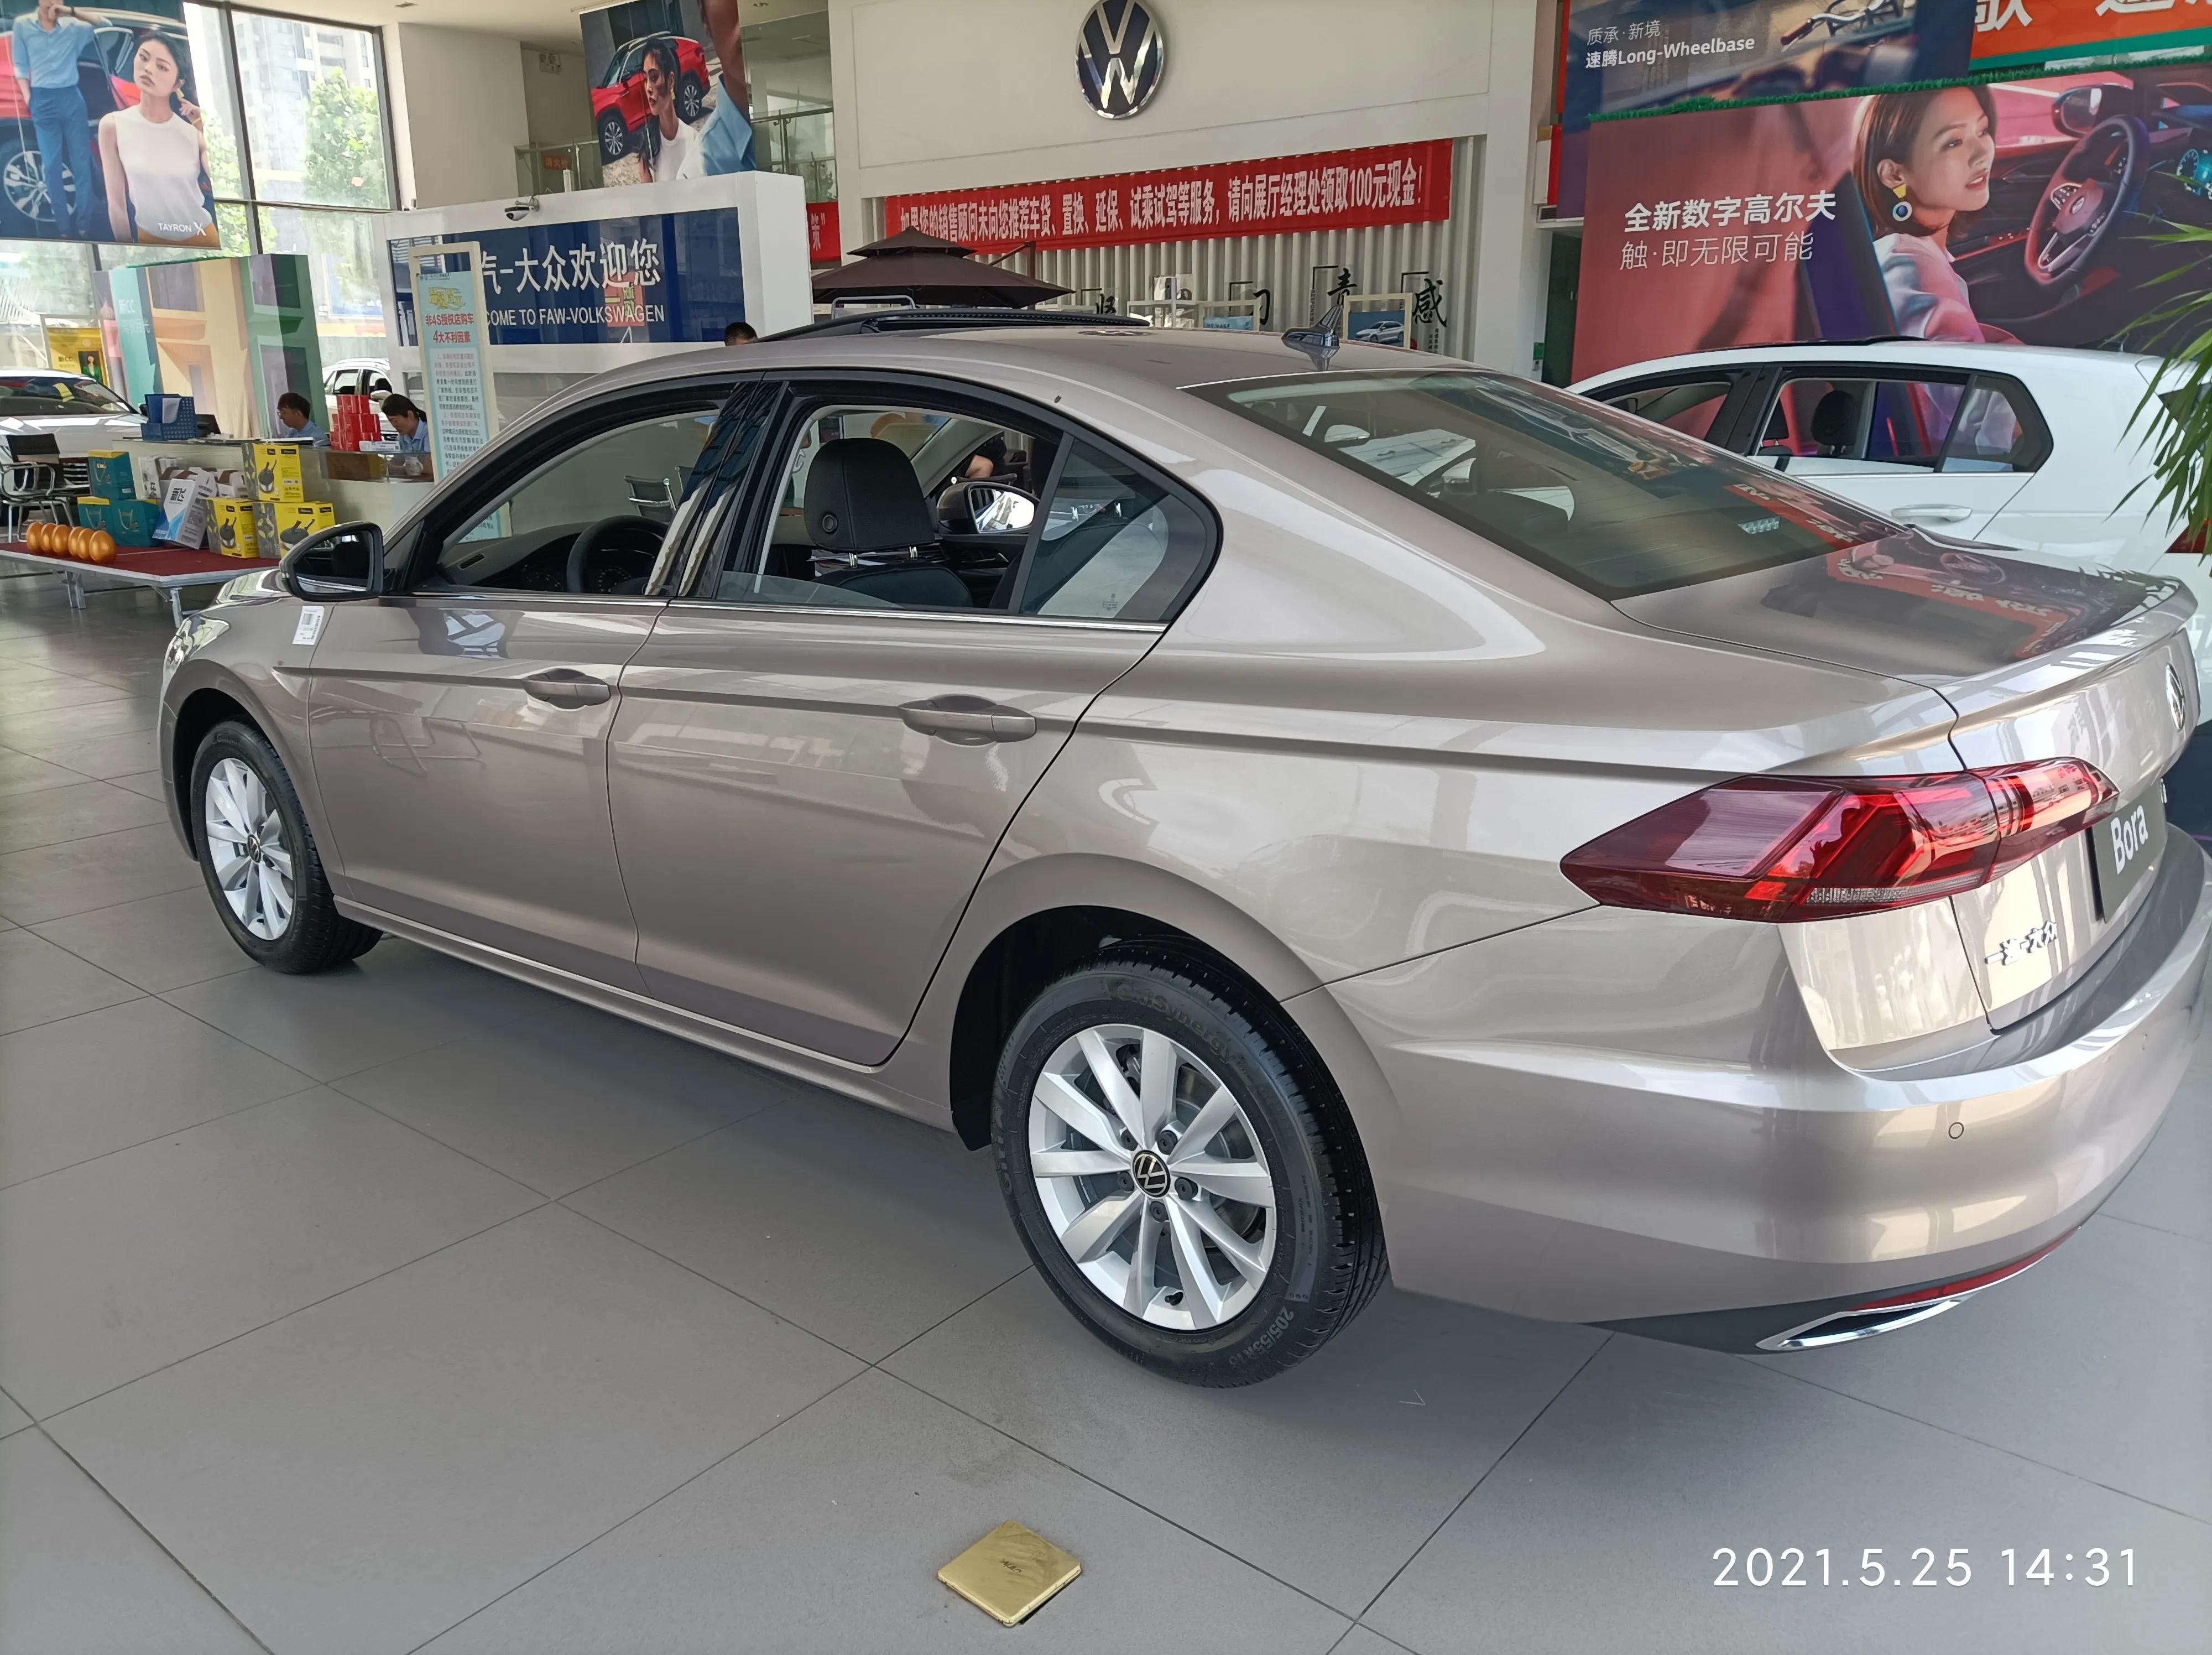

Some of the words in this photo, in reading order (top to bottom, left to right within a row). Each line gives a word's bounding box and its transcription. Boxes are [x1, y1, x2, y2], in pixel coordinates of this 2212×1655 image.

[1585, 38, 1755, 69] 速腾Long-Wheelbase
[1624, 190, 1837, 232] 全新数字高尔夫
[158, 222, 192, 232] TAYRON
[1620, 231, 1814, 270] 触·即无限可能
[519, 309, 536, 325] TO
[540, 304, 665, 325] FAW-VOLKSWAGEN
[1412, 278, 1447, 327] 感
[425, 313, 474, 326] 非4S授权店购车
[432, 330, 471, 344] 4大不利因素
[2111, 804, 2149, 875] Bora
